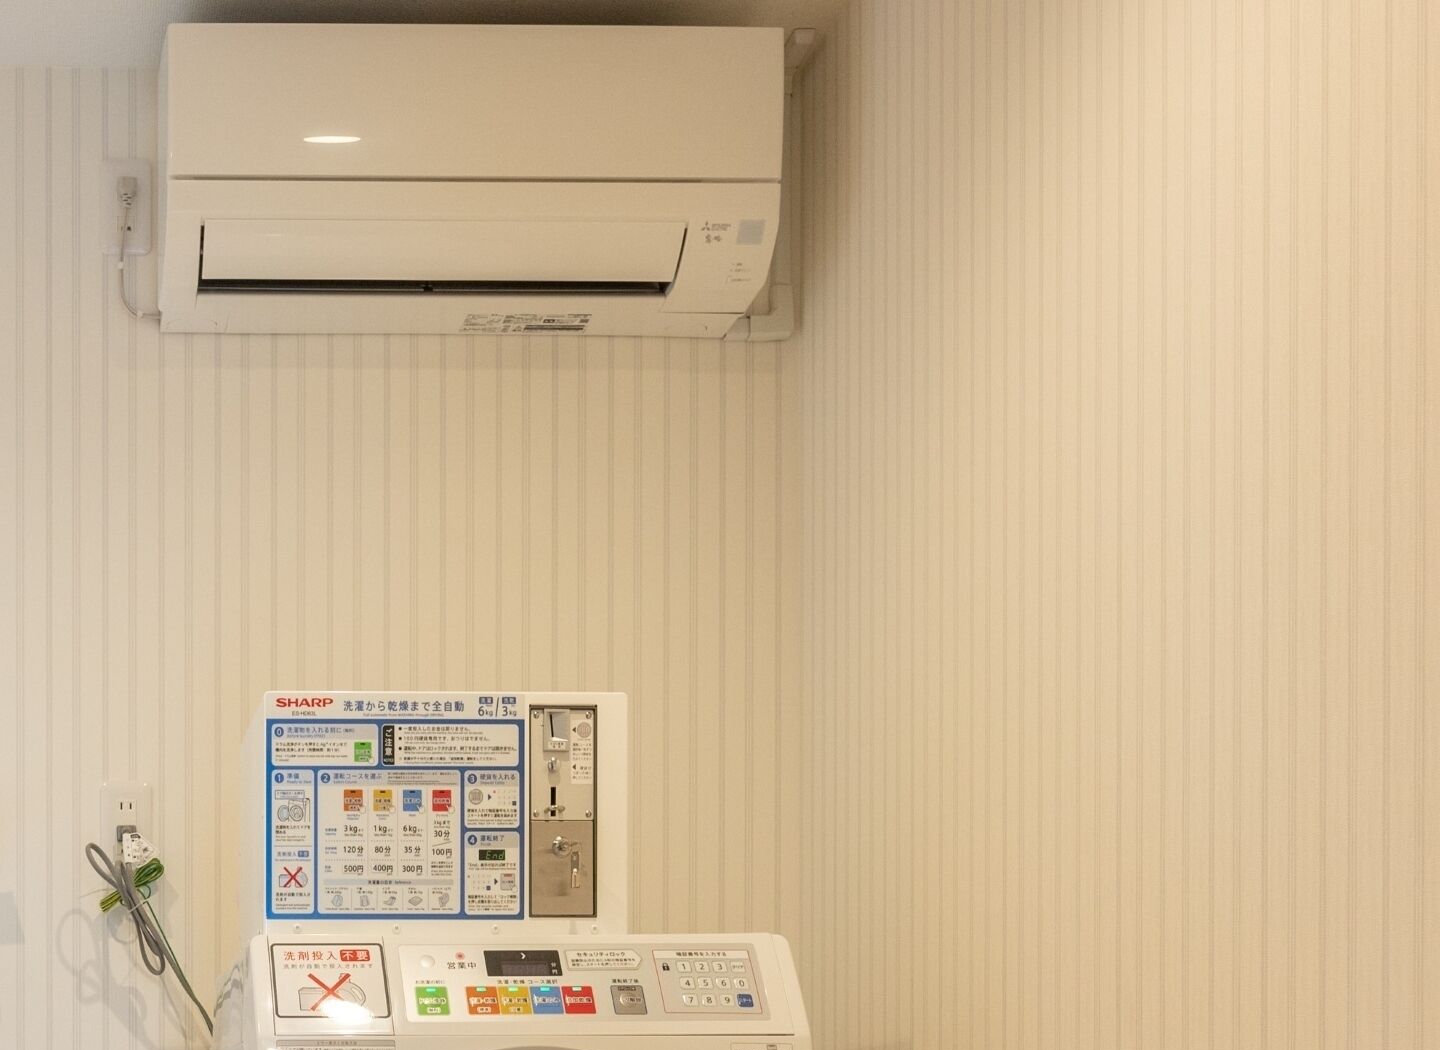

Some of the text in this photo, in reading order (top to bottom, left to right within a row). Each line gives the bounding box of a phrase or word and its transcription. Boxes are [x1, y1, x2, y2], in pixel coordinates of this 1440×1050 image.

[276, 698, 334, 708] SHARP
[344, 700, 464, 712] 洗濯から乾燥まで全自動
[433, 830, 450, 838] 30分
[470, 836, 475, 844] 4
[343, 846, 364, 854] 120分
[374, 846, 391, 854] 80分
[404, 846, 420, 854] 35分
[432, 849, 452, 857] 100円
[485, 851, 504, 860] End
[344, 865, 364, 873] 500円
[373, 865, 393, 873] 400円
[402, 865, 422, 873] 300円
[284, 951, 370, 961] 洗剤投入 不要
[447, 961, 477, 970] 営業中
[706, 996, 712, 1004] 8
[724, 996, 730, 1004] 9
